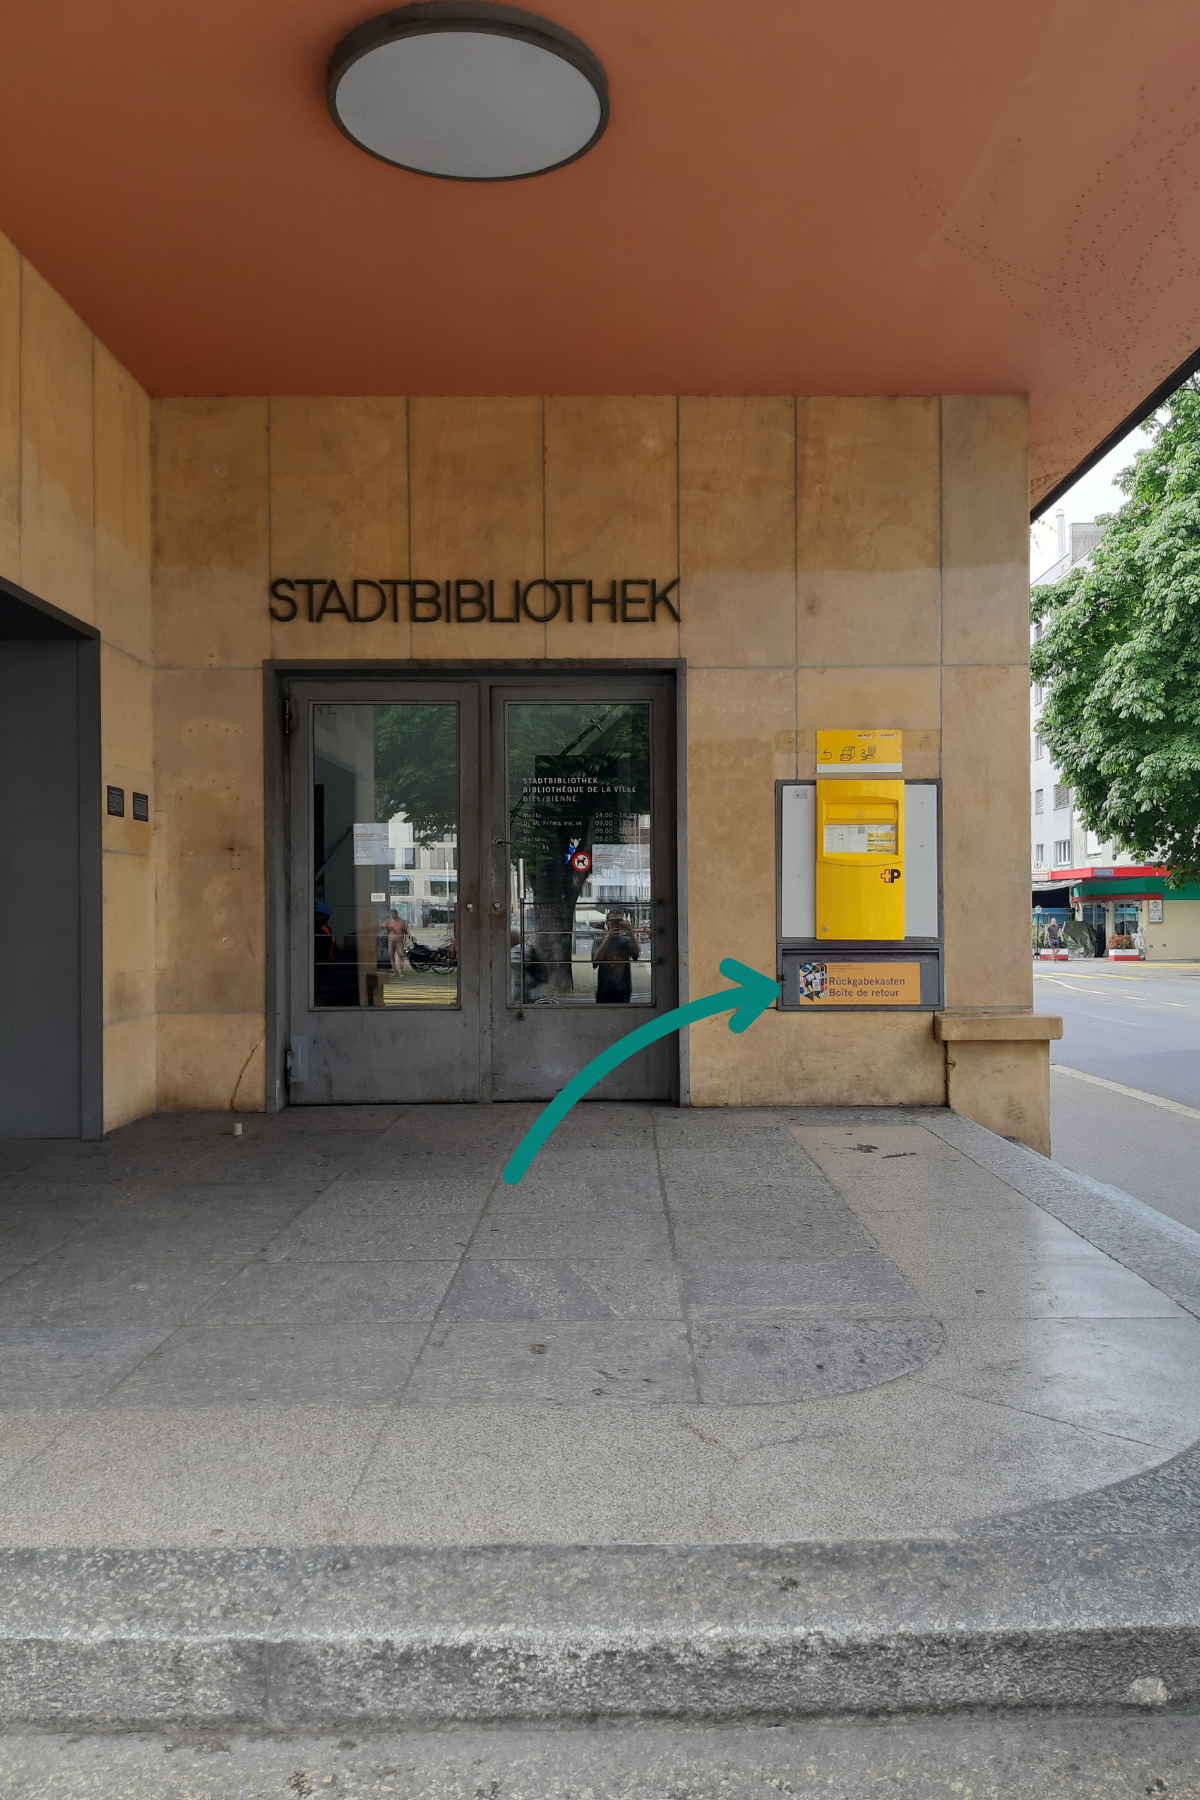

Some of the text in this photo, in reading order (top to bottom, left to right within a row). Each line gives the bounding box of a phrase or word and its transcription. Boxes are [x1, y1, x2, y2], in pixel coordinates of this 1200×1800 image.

[269, 578, 682, 624] STADTBIBLIOTHEK
[522, 777, 599, 785] STADTBIBLIOTHEK
[522, 785, 585, 793] BIBLIOTHÈQUE
[828, 976, 905, 987] Rückgabekasten
[829, 988, 899, 997] Boîte de retour
